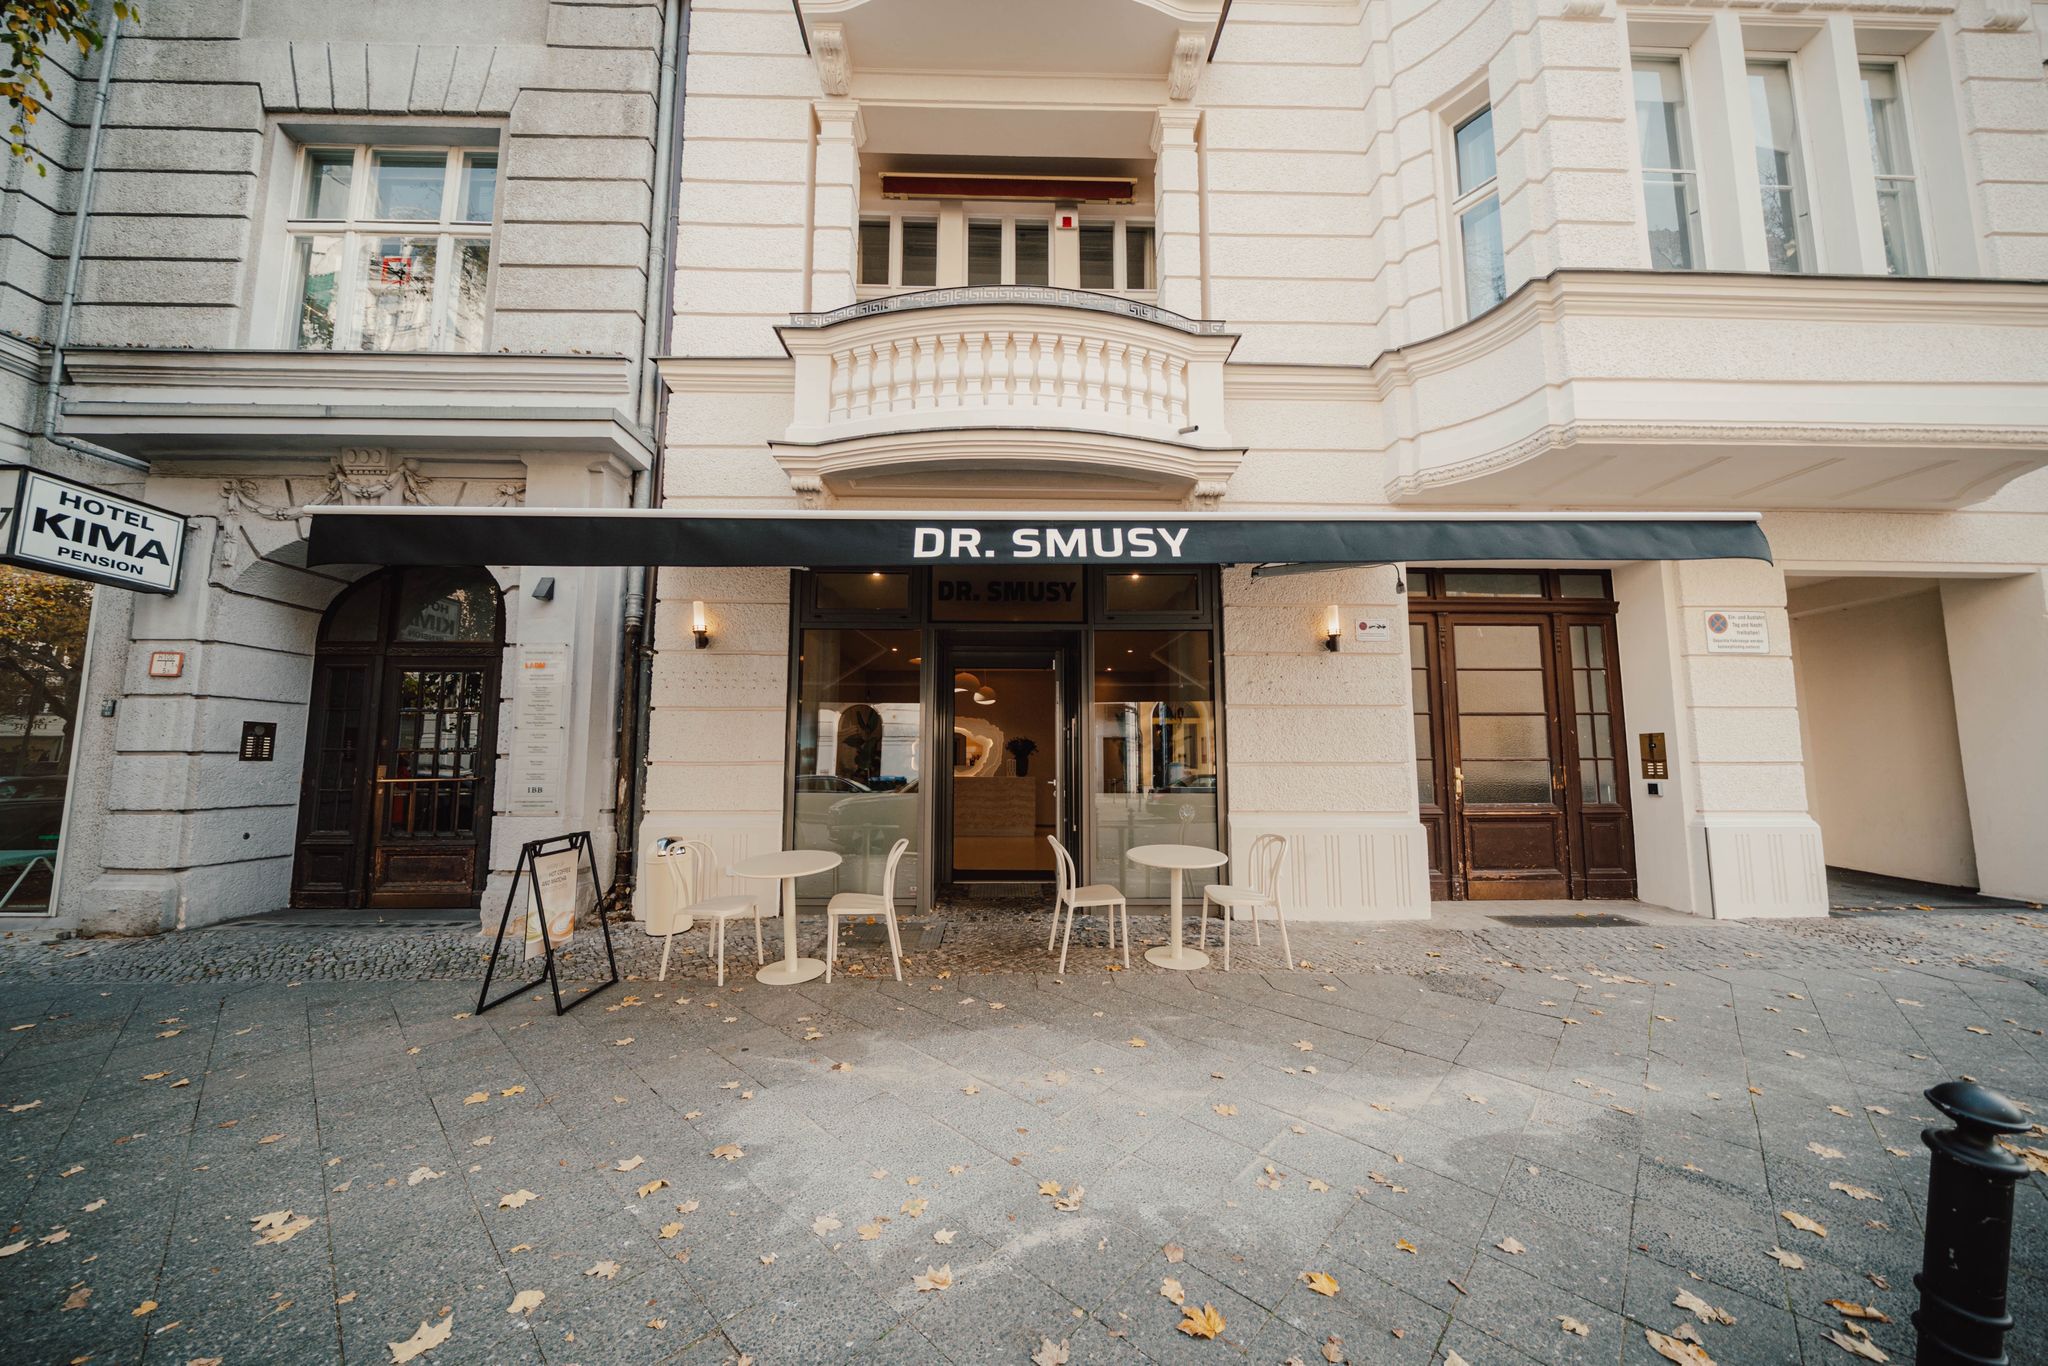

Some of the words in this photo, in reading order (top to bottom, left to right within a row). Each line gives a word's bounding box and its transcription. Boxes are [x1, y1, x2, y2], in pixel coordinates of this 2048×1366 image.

[59, 490, 155, 532] HOTEL
[32, 506, 170, 566] KIMA
[913, 527, 995, 558] DR.
[1012, 527, 1189, 558] SMUSY
[57, 546, 144, 575] PENSION
[938, 580, 980, 601] DR.
[987, 581, 1077, 601] SMUSY
